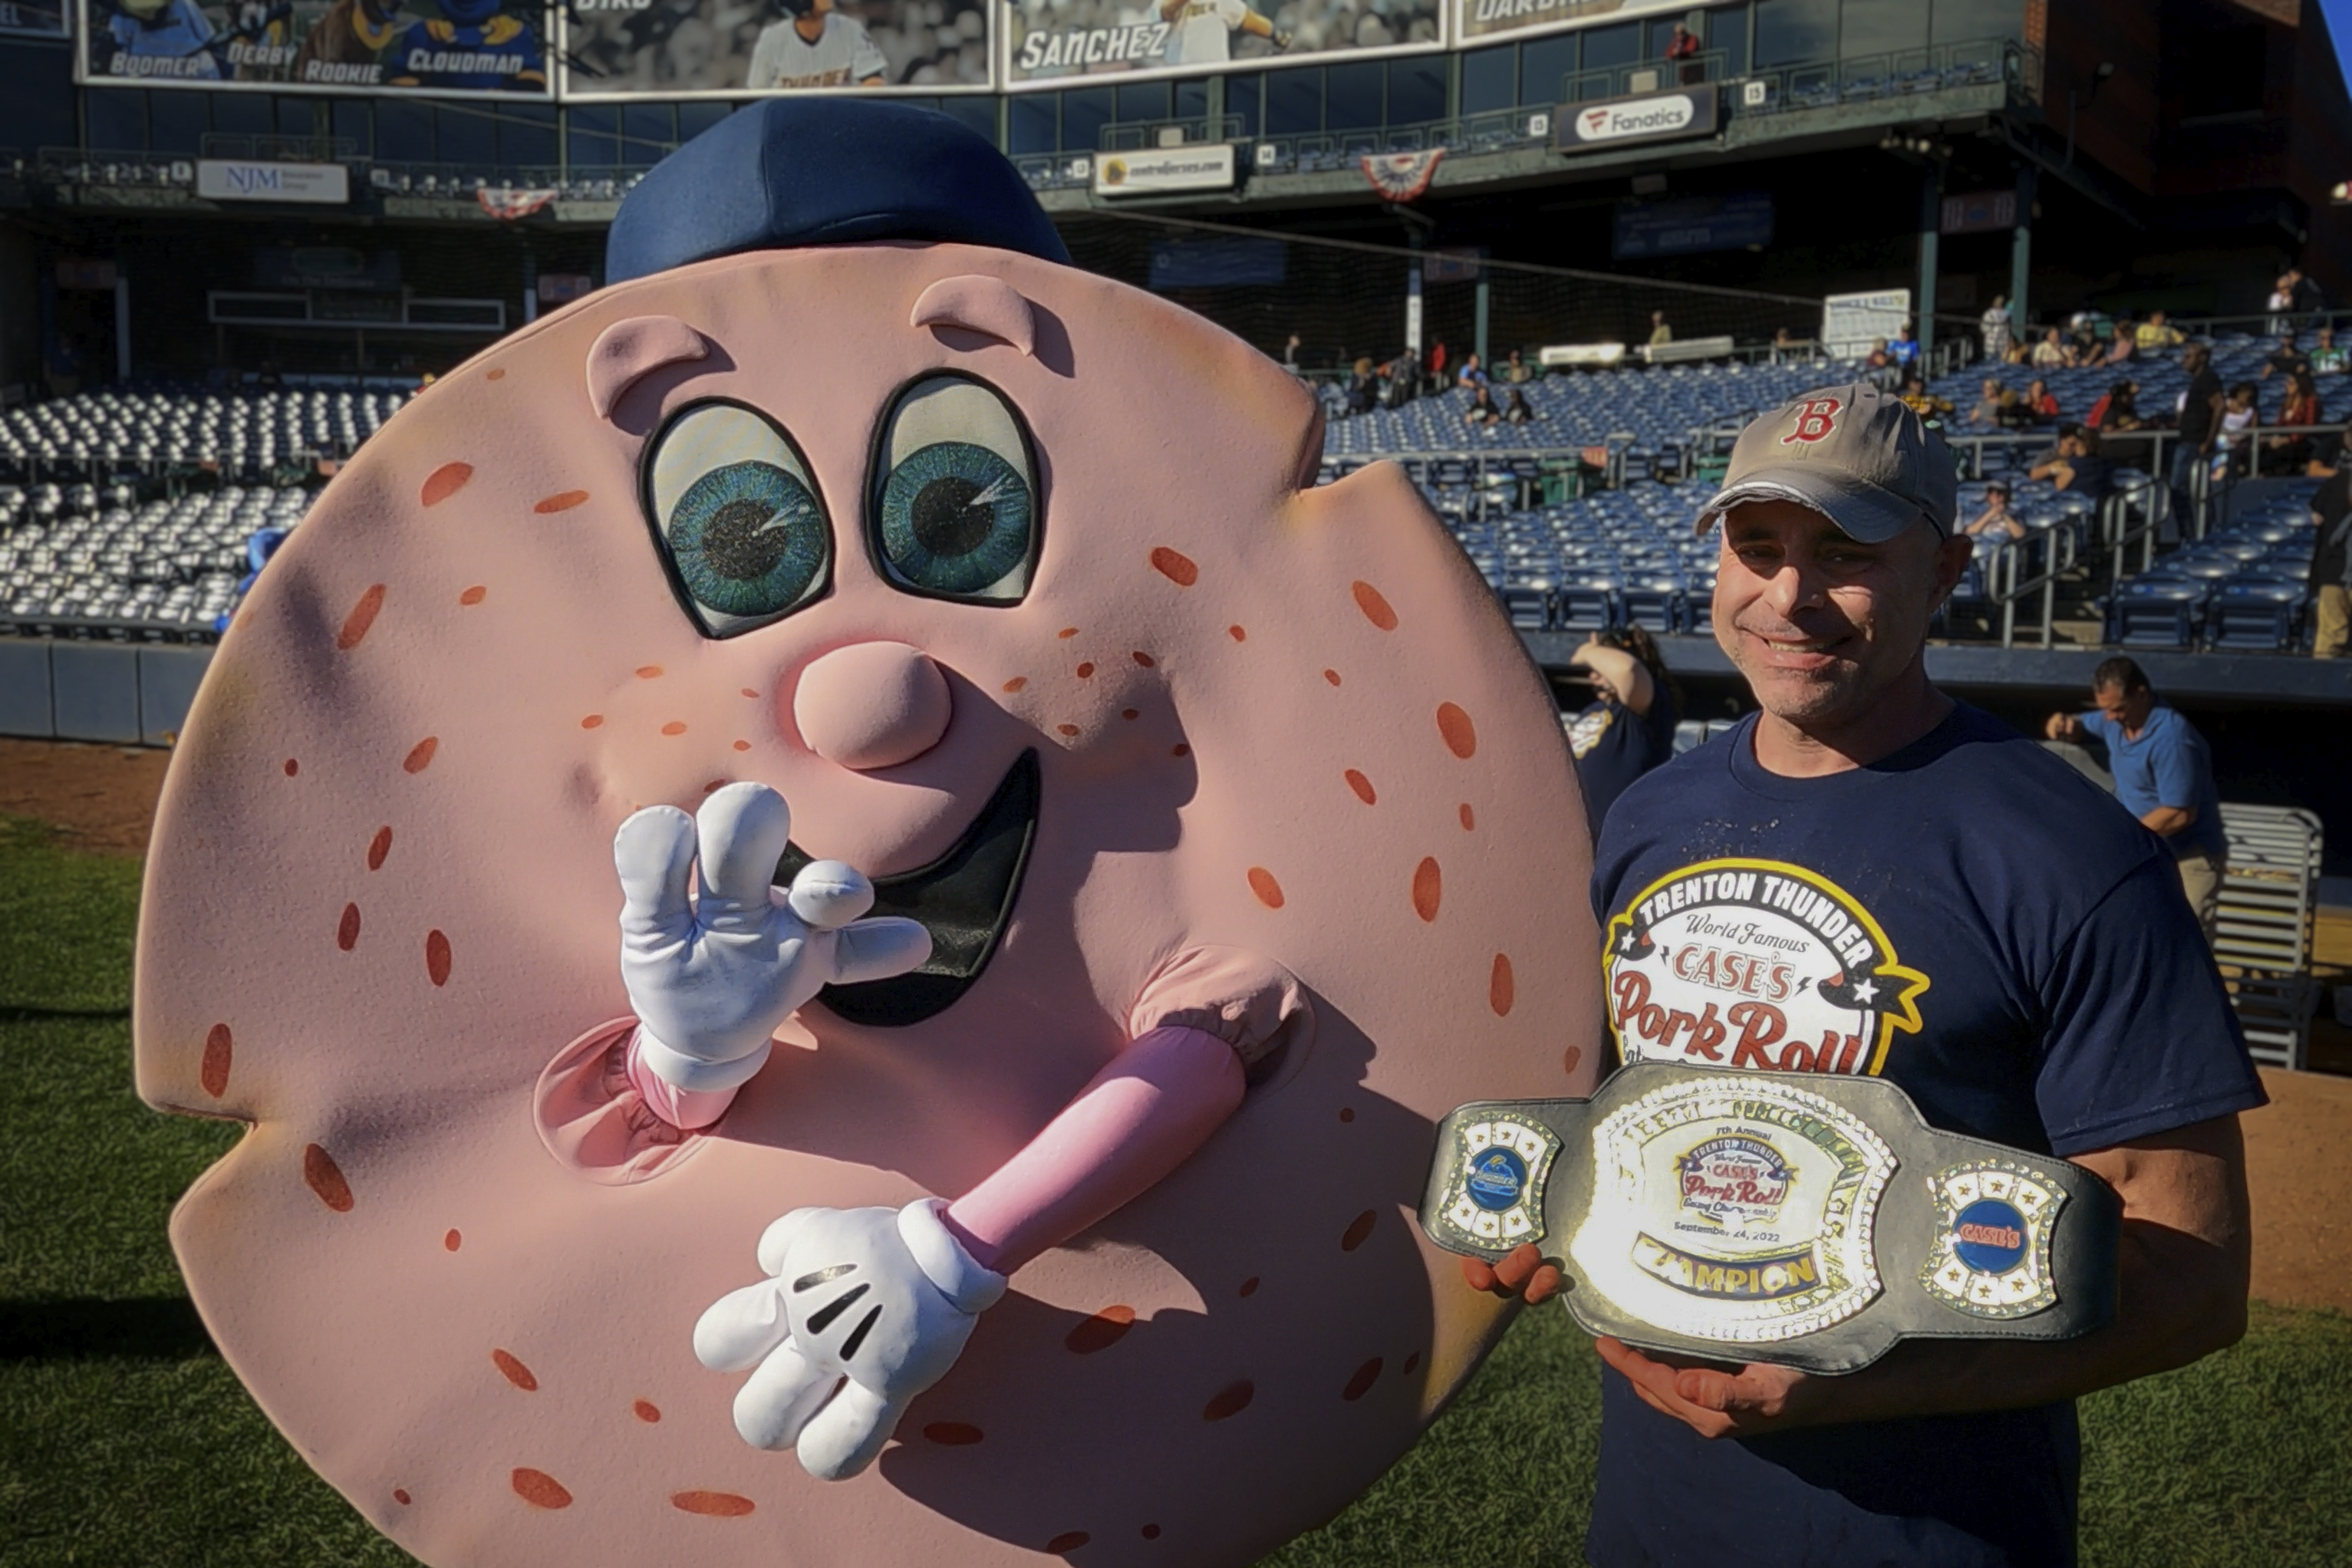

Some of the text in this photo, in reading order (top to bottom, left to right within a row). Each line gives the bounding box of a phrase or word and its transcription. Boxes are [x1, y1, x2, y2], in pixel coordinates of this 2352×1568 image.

[228, 43, 298, 66] DERBY
[1020, 21, 1171, 70] SANCHEZ
[110, 52, 199, 77] BOOMER
[305, 60, 382, 84] ROOKIE
[407, 48, 523, 74] CLOUDMAN
[1612, 107, 1684, 131] Fanatics
[226, 166, 278, 193] NJM
[1780, 398, 1843, 446] B
[1639, 872, 1873, 969] TRENTON THUNDER
[1686, 914, 1810, 954] World Famous
[1673, 942, 1795, 1003] CASE'S
[1615, 970, 1863, 1073] Pork Roll
[1716, 1125, 1772, 1141] 7th Annual
[1692, 1139, 1783, 1168] TRENTON THUNDER
[1685, 1175, 1782, 1205] Pork Roll
[1674, 1221, 1730, 1237] September
[1752, 1231, 1780, 1242] 2022
